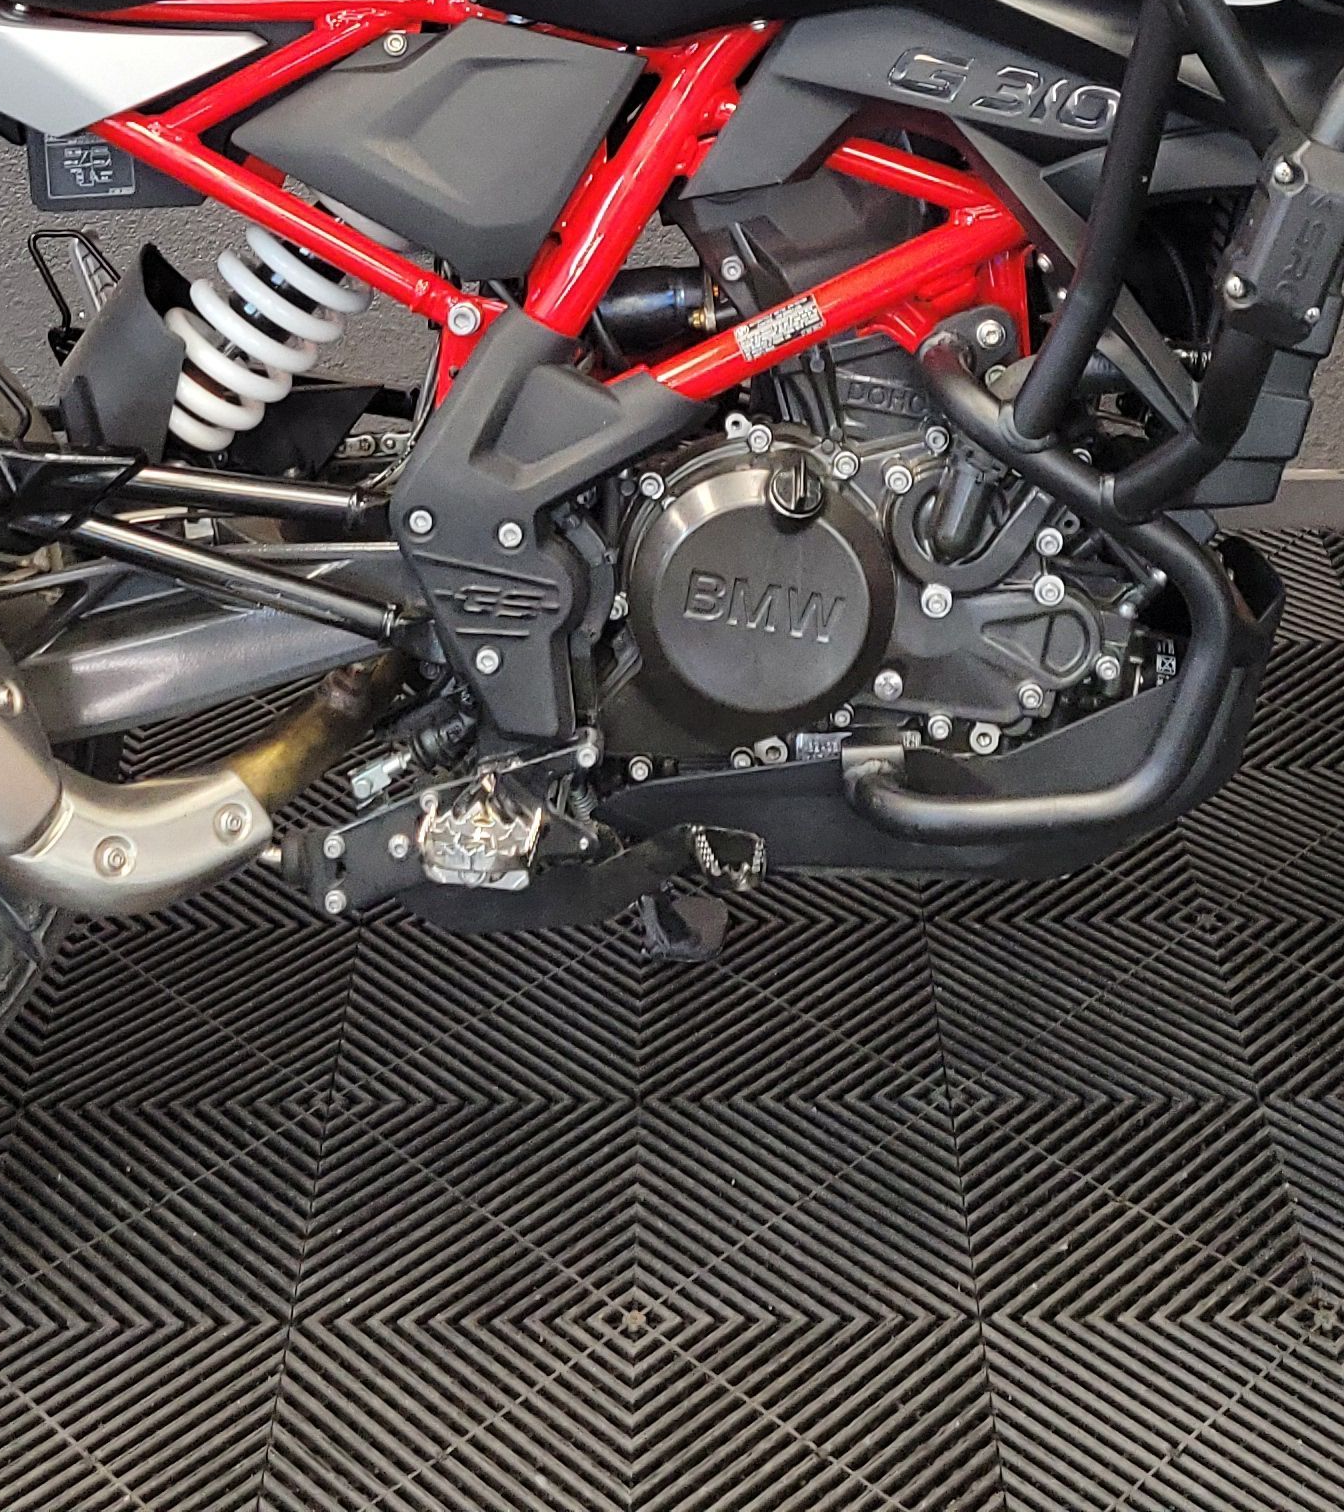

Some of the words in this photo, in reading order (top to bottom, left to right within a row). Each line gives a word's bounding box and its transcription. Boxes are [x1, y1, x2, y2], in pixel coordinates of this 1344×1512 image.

[887, 46, 976, 104] G
[969, 64, 1124, 134] 310
[682, 567, 847, 644] BMW
